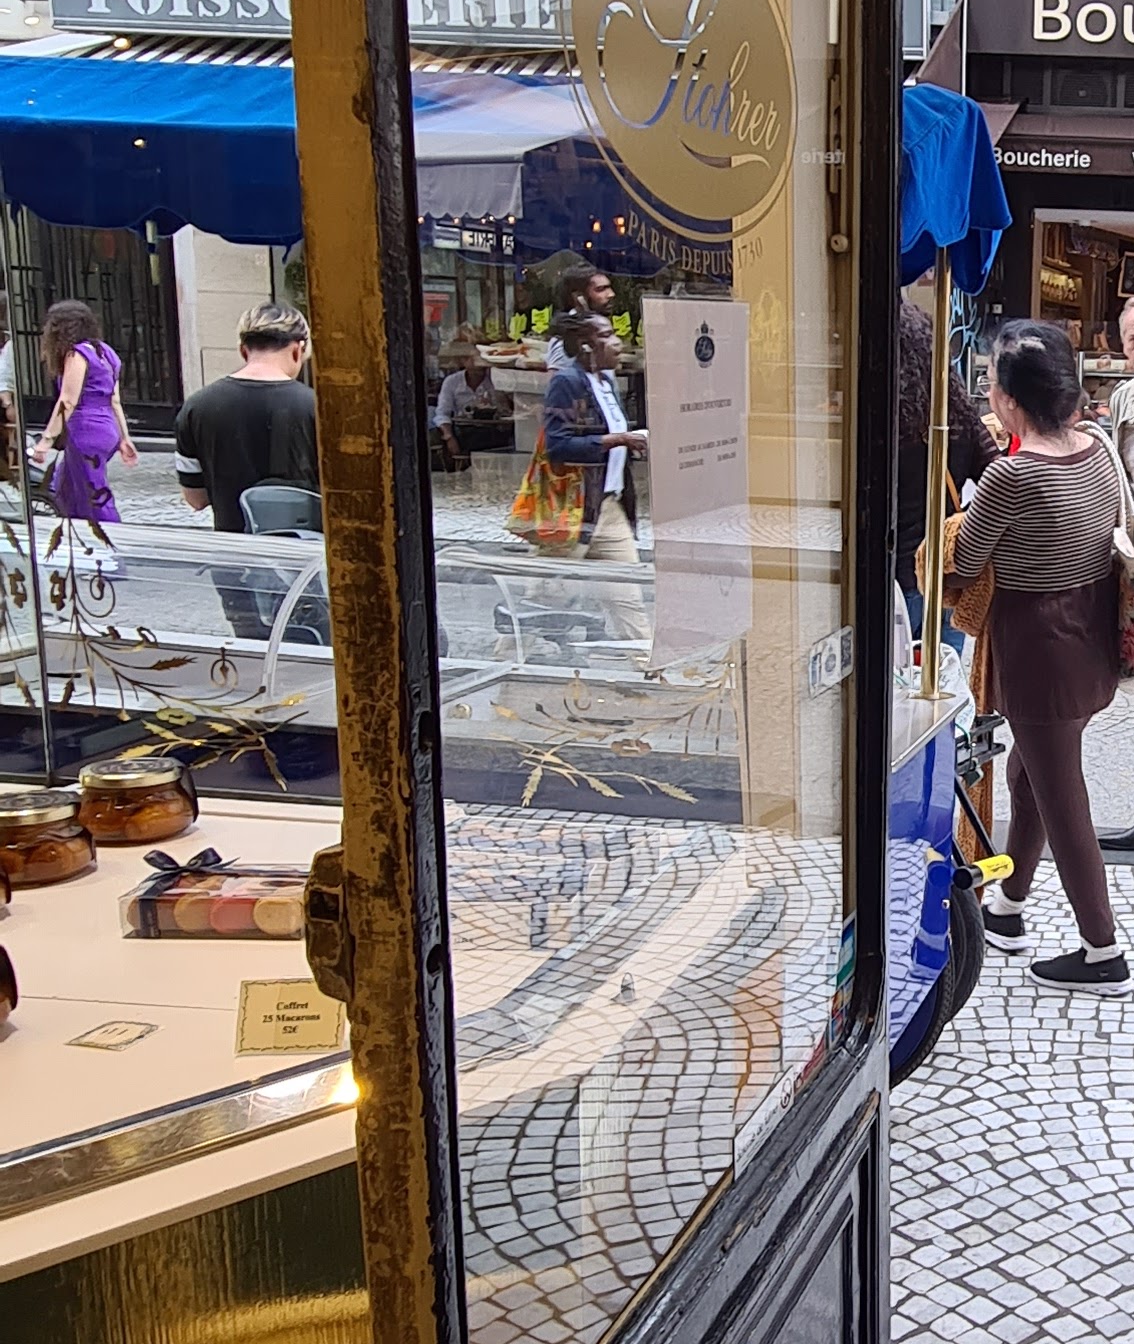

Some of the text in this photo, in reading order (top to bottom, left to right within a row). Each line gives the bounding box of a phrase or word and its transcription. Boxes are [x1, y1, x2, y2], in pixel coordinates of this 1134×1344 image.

[994, 147, 1092, 168] Boucherie
[627, 209, 763, 275] PARIS DEPUIS 1730
[276, 1001, 309, 1011] Coffret
[262, 1013, 321, 1023] 25 Macarons
